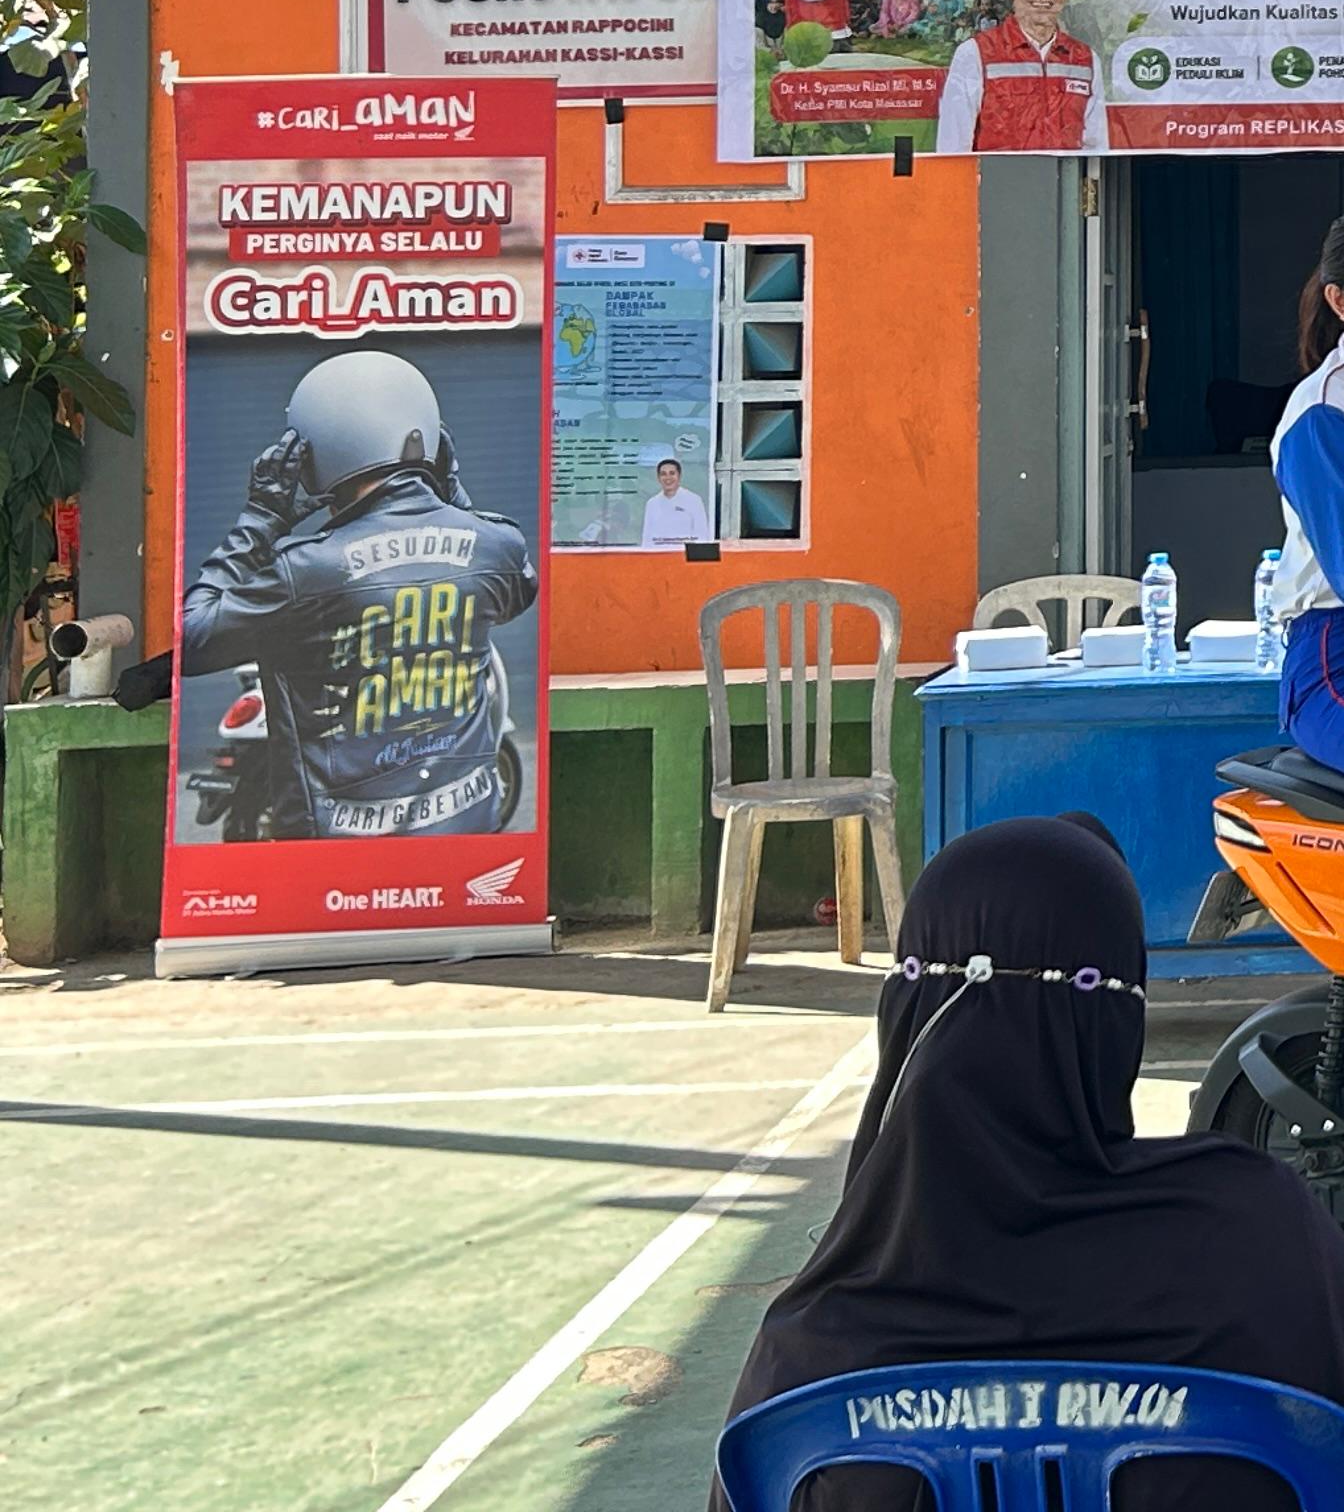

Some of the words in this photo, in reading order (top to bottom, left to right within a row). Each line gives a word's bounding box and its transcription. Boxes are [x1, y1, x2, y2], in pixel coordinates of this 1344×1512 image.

[1171, 6, 1260, 23] Wujudkan
[1265, 4, 1338, 20] Kualitas
[450, 20, 568, 37] KECAMATAN
[572, 18, 674, 33] RAPPOCINI
[444, 48, 559, 65] KELURAHAN
[561, 46, 683, 62] KASSI-KASSI
[1166, 120, 1245, 139] Program
[220, 183, 511, 227] KEMANAPUN
[246, 232, 375, 255] PERGINYA
[381, 230, 483, 252] SELALU
[218, 276, 512, 327] Cari_Aman
[350, 537, 472, 569] SESUDAH
[329, 583, 476, 670] #CARI
[354, 650, 480, 738] AMAN
[335, 804, 386, 829] CARI
[393, 772, 489, 825] GEBETAN
[183, 894, 257, 910] AHM
[325, 891, 369, 911] One
[372, 888, 443, 909] HEART.
[466, 895, 525, 905] HONDA
[1018, 1381, 1047, 1427] I
